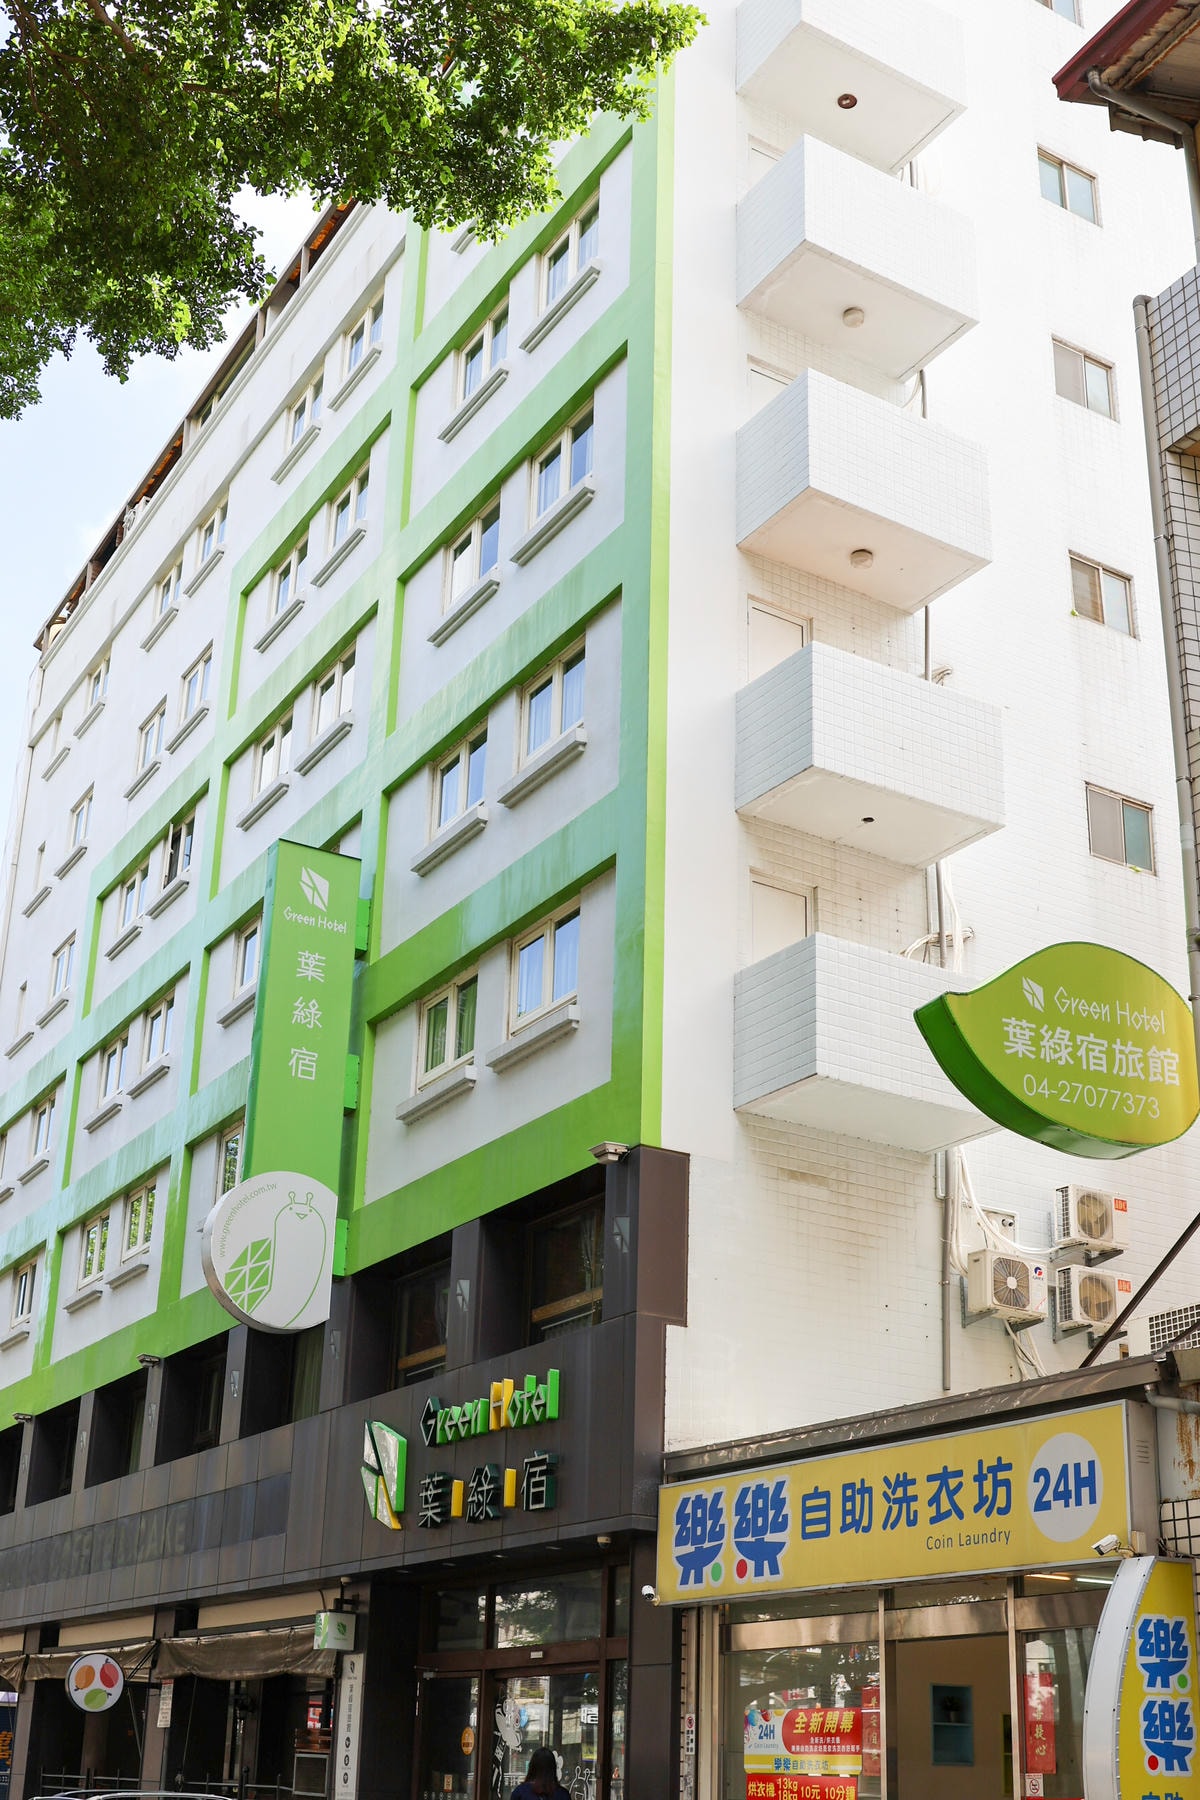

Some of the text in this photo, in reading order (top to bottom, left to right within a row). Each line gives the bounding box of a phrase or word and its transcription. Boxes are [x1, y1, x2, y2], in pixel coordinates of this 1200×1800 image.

[284, 906, 347, 934] Green Hotel
[288, 950, 326, 1081] 葉綠宿
[1054, 986, 1165, 1035] Green Hotel
[1002, 1017, 1180, 1086] 葉綠宿旅館
[1023, 1073, 1160, 1119] 04-27077373
[219, 1183, 278, 1258] www.greenhotel.com.tw
[419, 1369, 560, 1447] Green Hotel
[801, 1456, 1013, 1541] 自助洗衣坊
[1033, 1459, 1097, 1513] 24H
[926, 1527, 1011, 1550] Coin Laundry
[758, 1724, 775, 1740] 24H
[792, 1711, 856, 1734] 全新開幕
[777, 1778, 798, 1791] 13kg
